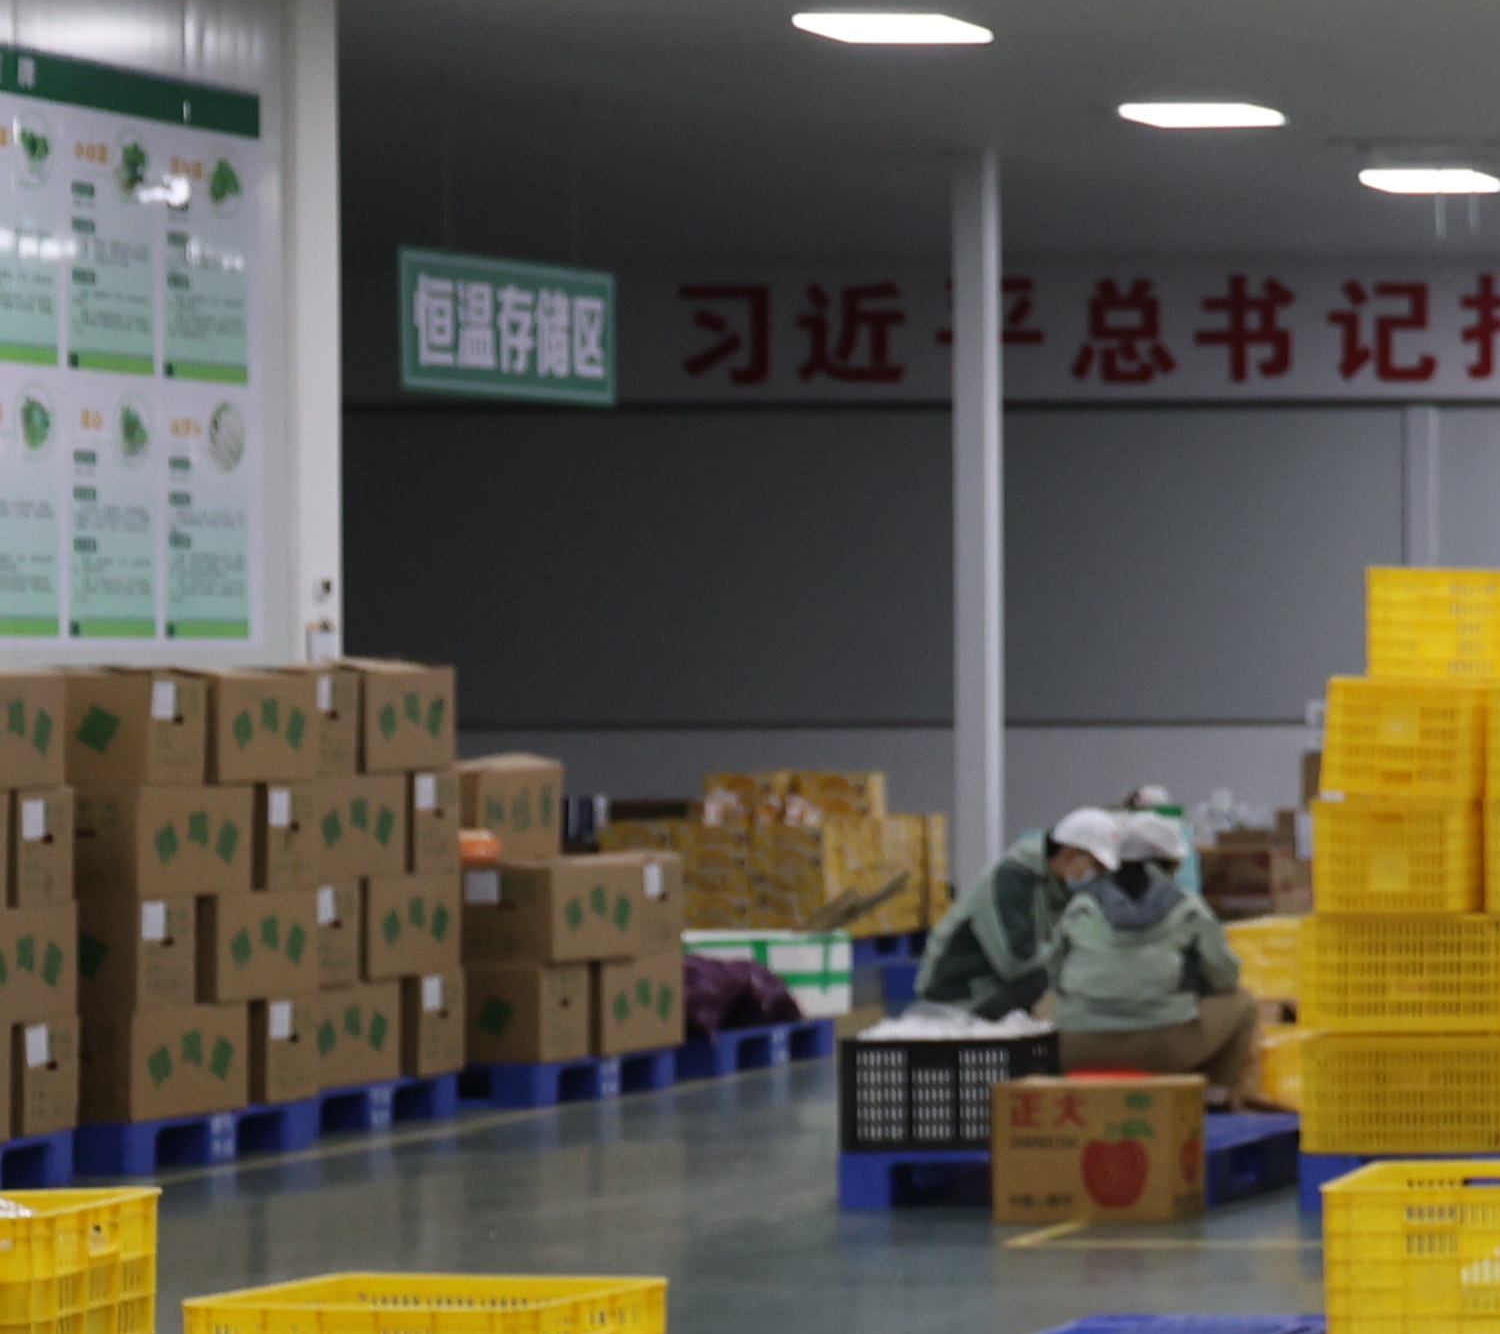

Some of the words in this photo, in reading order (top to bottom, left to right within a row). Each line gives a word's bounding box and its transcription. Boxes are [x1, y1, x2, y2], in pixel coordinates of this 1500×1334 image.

[413, 272, 605, 378] 恒温存储区
